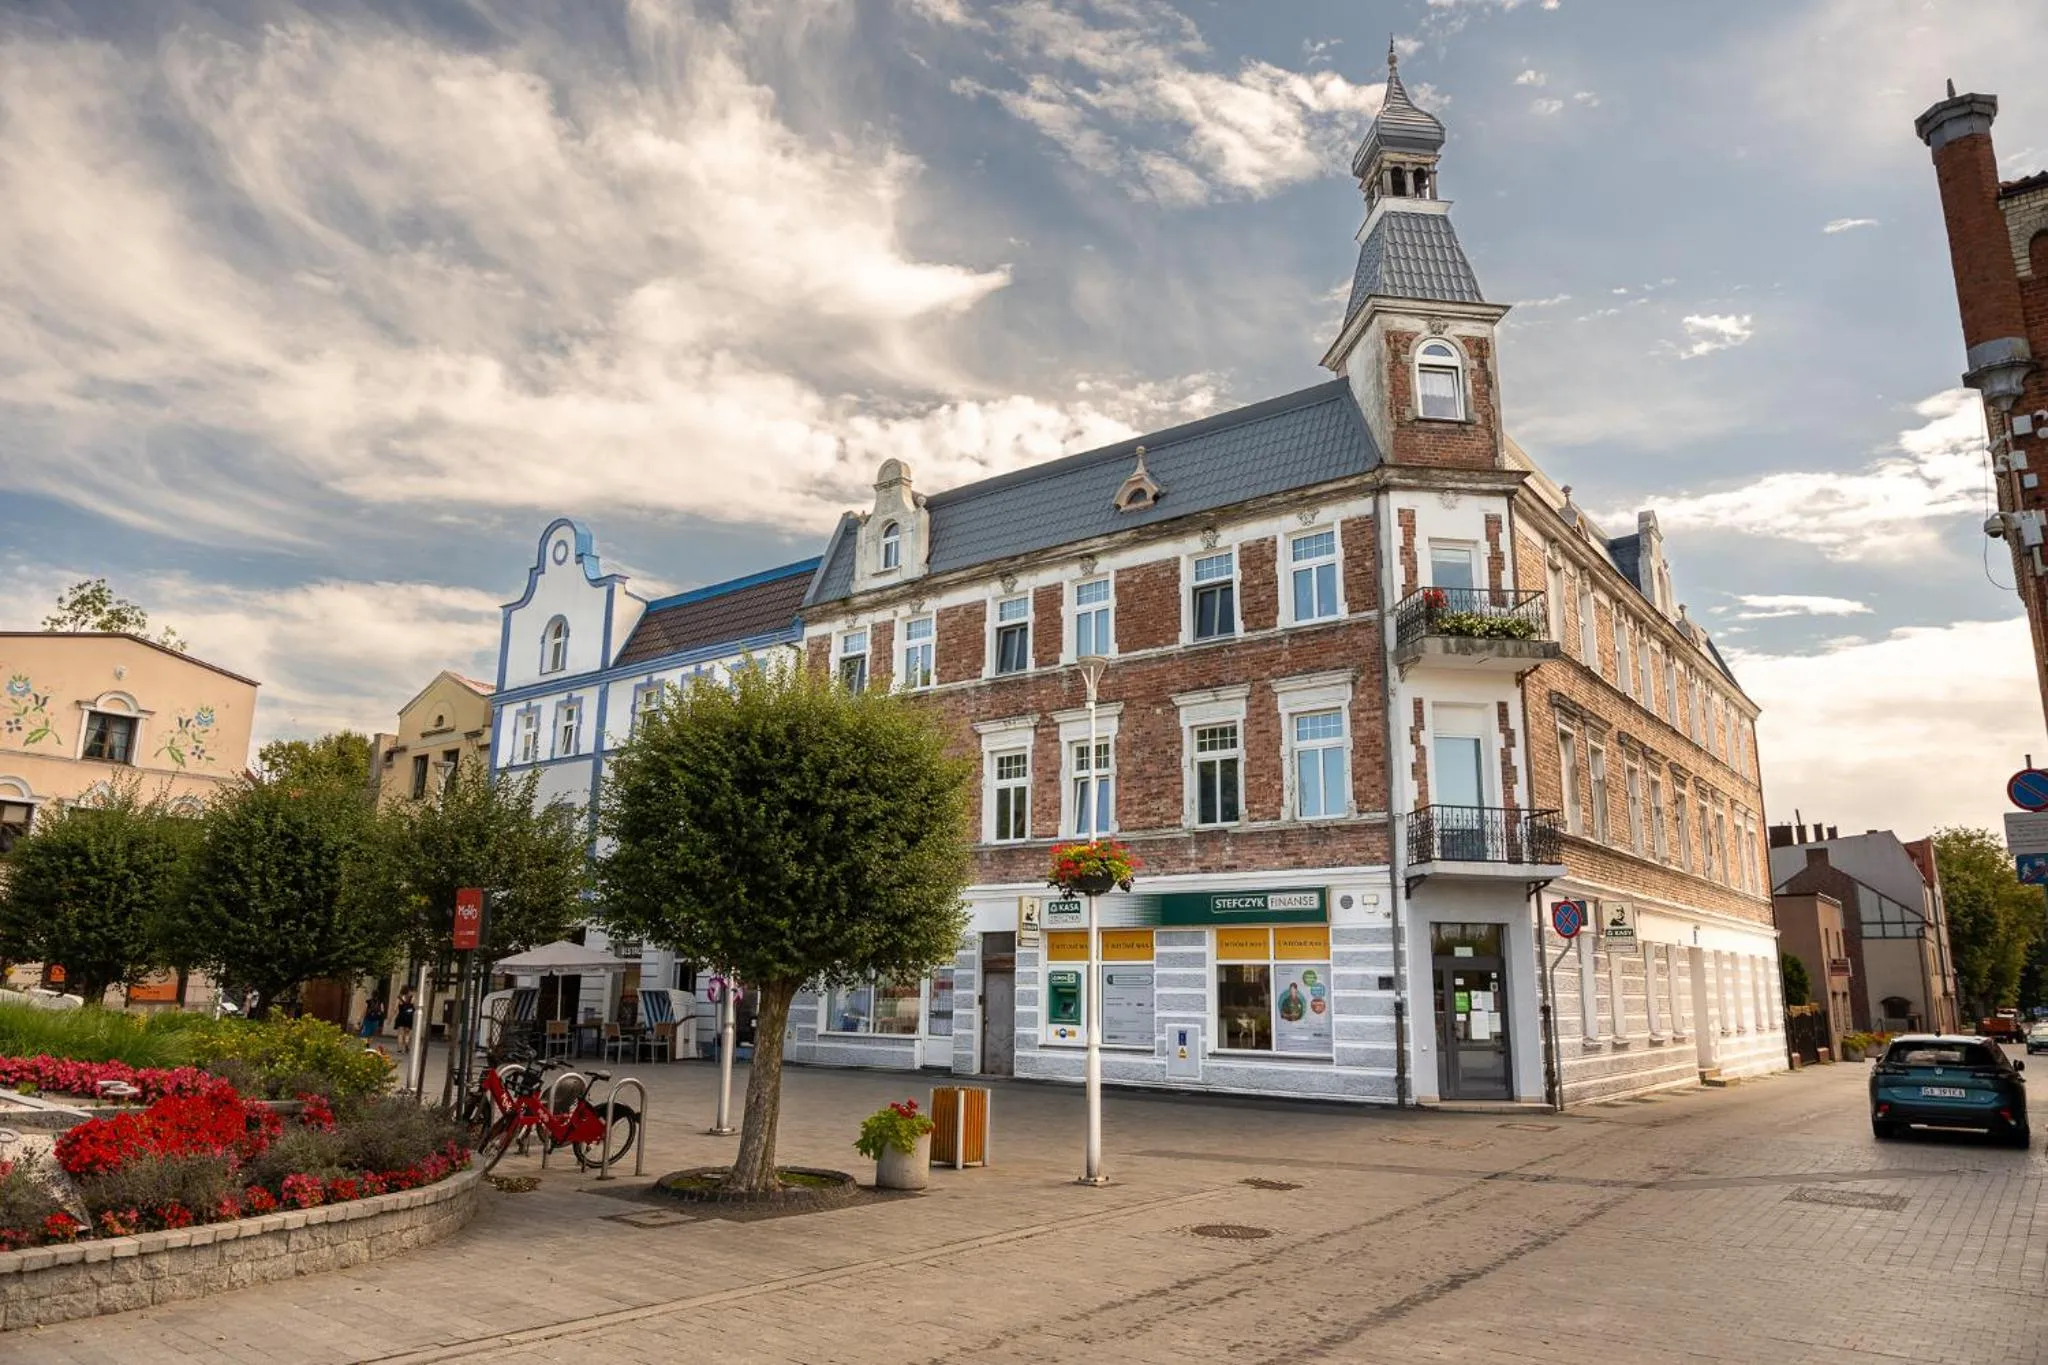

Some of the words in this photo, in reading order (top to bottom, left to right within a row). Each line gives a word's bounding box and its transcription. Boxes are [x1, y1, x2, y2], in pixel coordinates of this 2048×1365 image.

[1058, 902, 1080, 912] KASA
[1215, 897, 1265, 909] STEFCZYK
[1270, 895, 1315, 908] FINANSE
